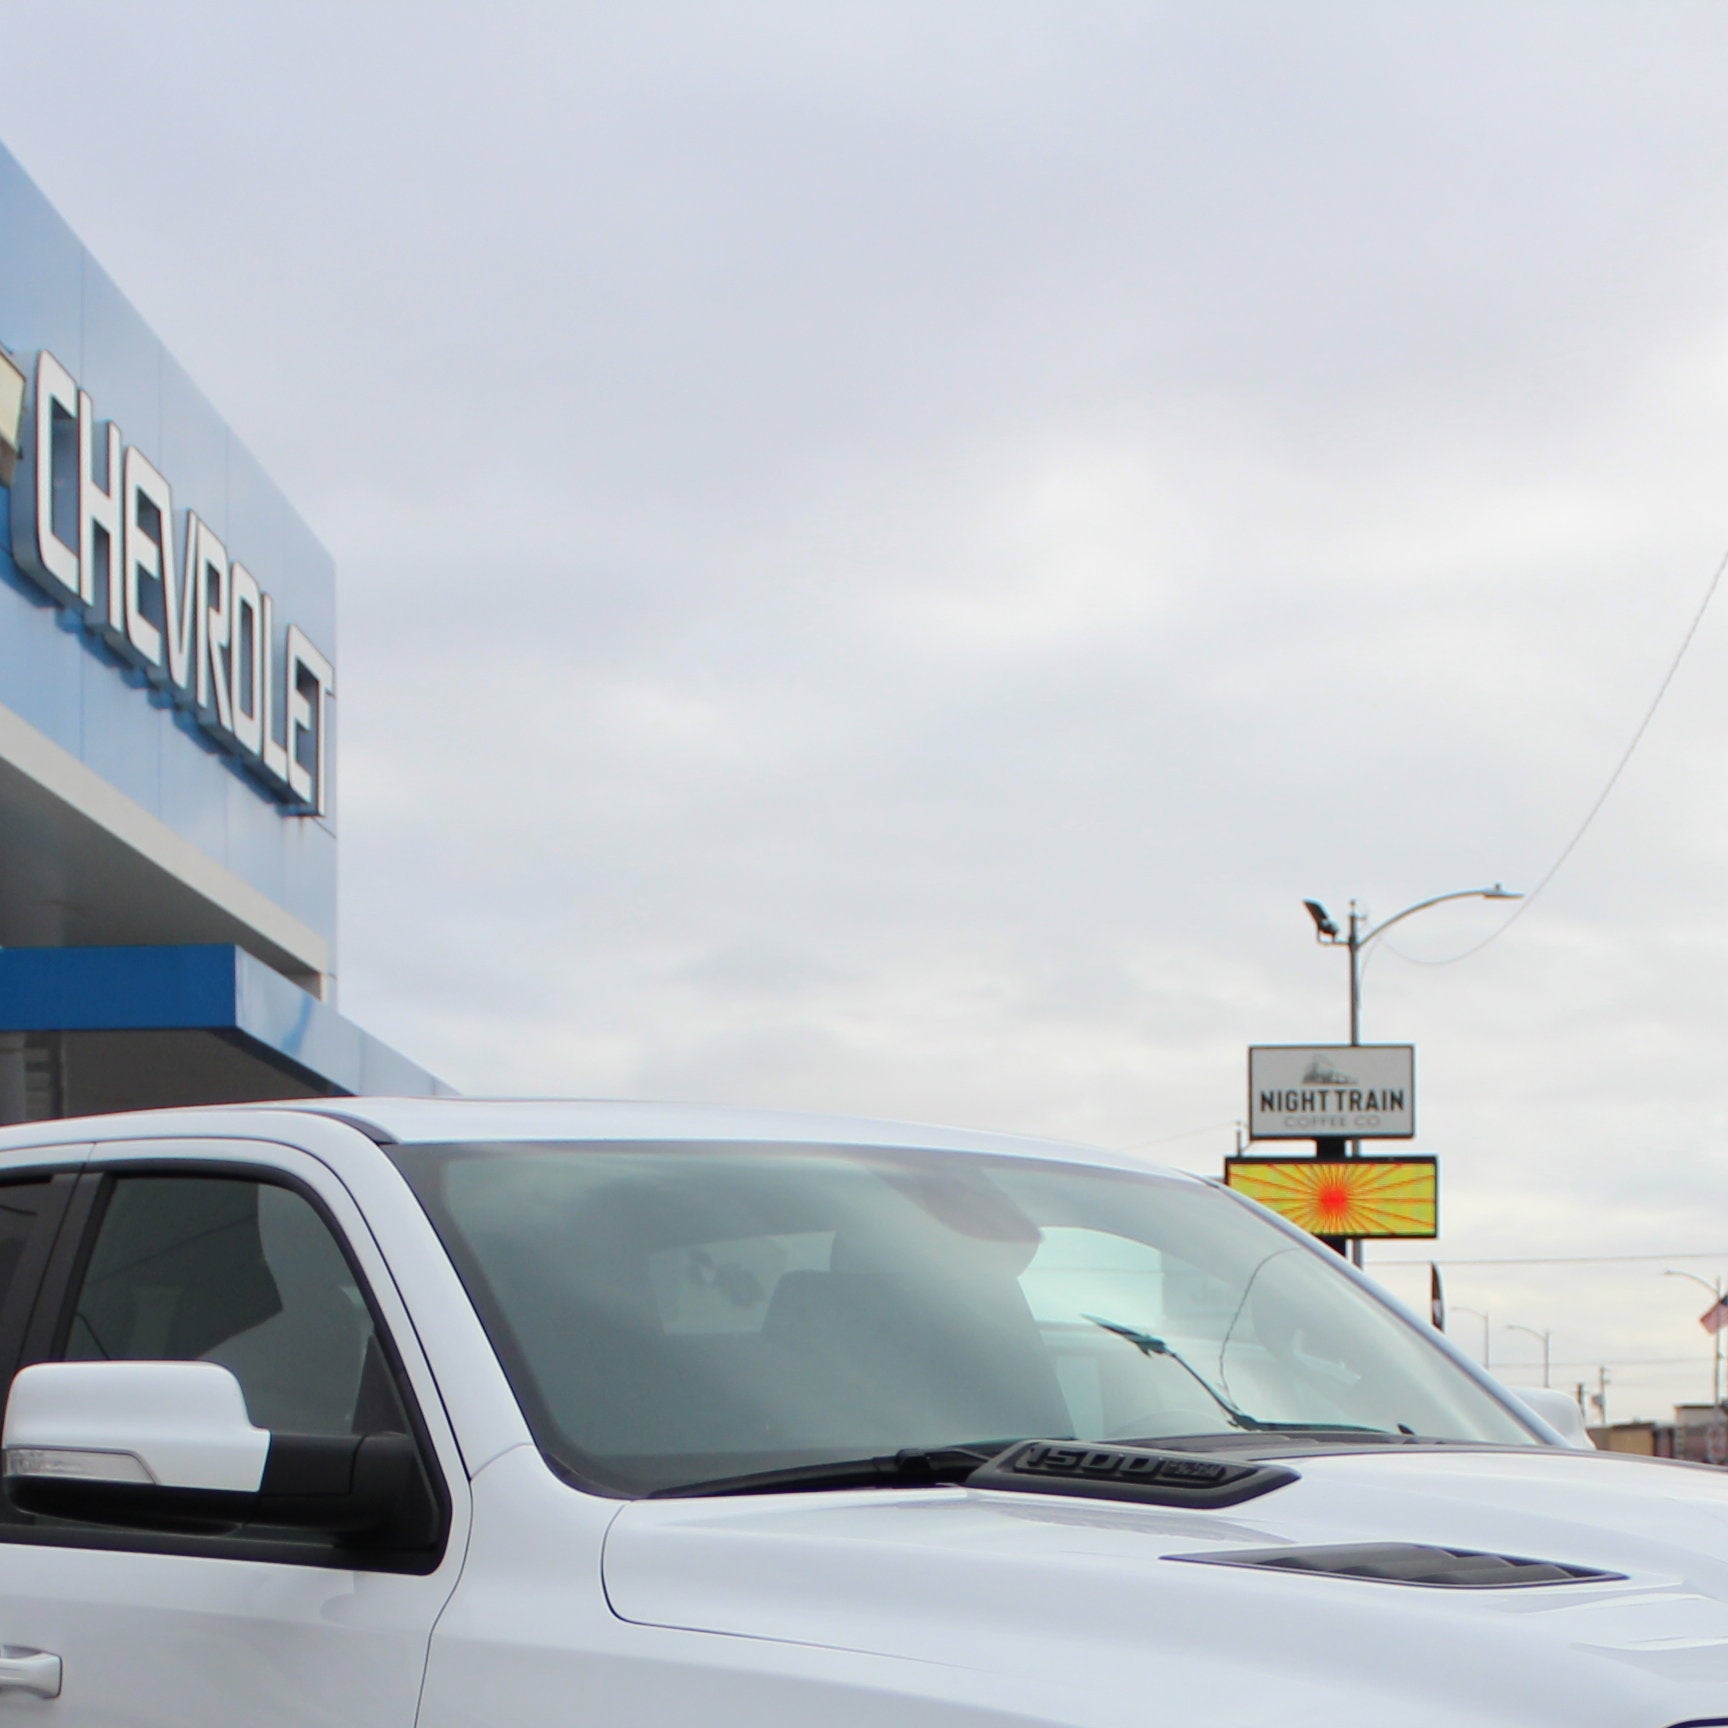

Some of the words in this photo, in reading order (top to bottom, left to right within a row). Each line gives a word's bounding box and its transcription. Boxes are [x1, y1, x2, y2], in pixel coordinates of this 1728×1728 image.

[14, 350, 337, 818] CHEVROLET
[1259, 1089, 1329, 1113] NIGHT
[1334, 1089, 1404, 1112] TRAIN
[1284, 1115, 1347, 1128] COFFEE
[1354, 1115, 1381, 1127] CO
[1025, 1446, 1161, 1474] 1500
